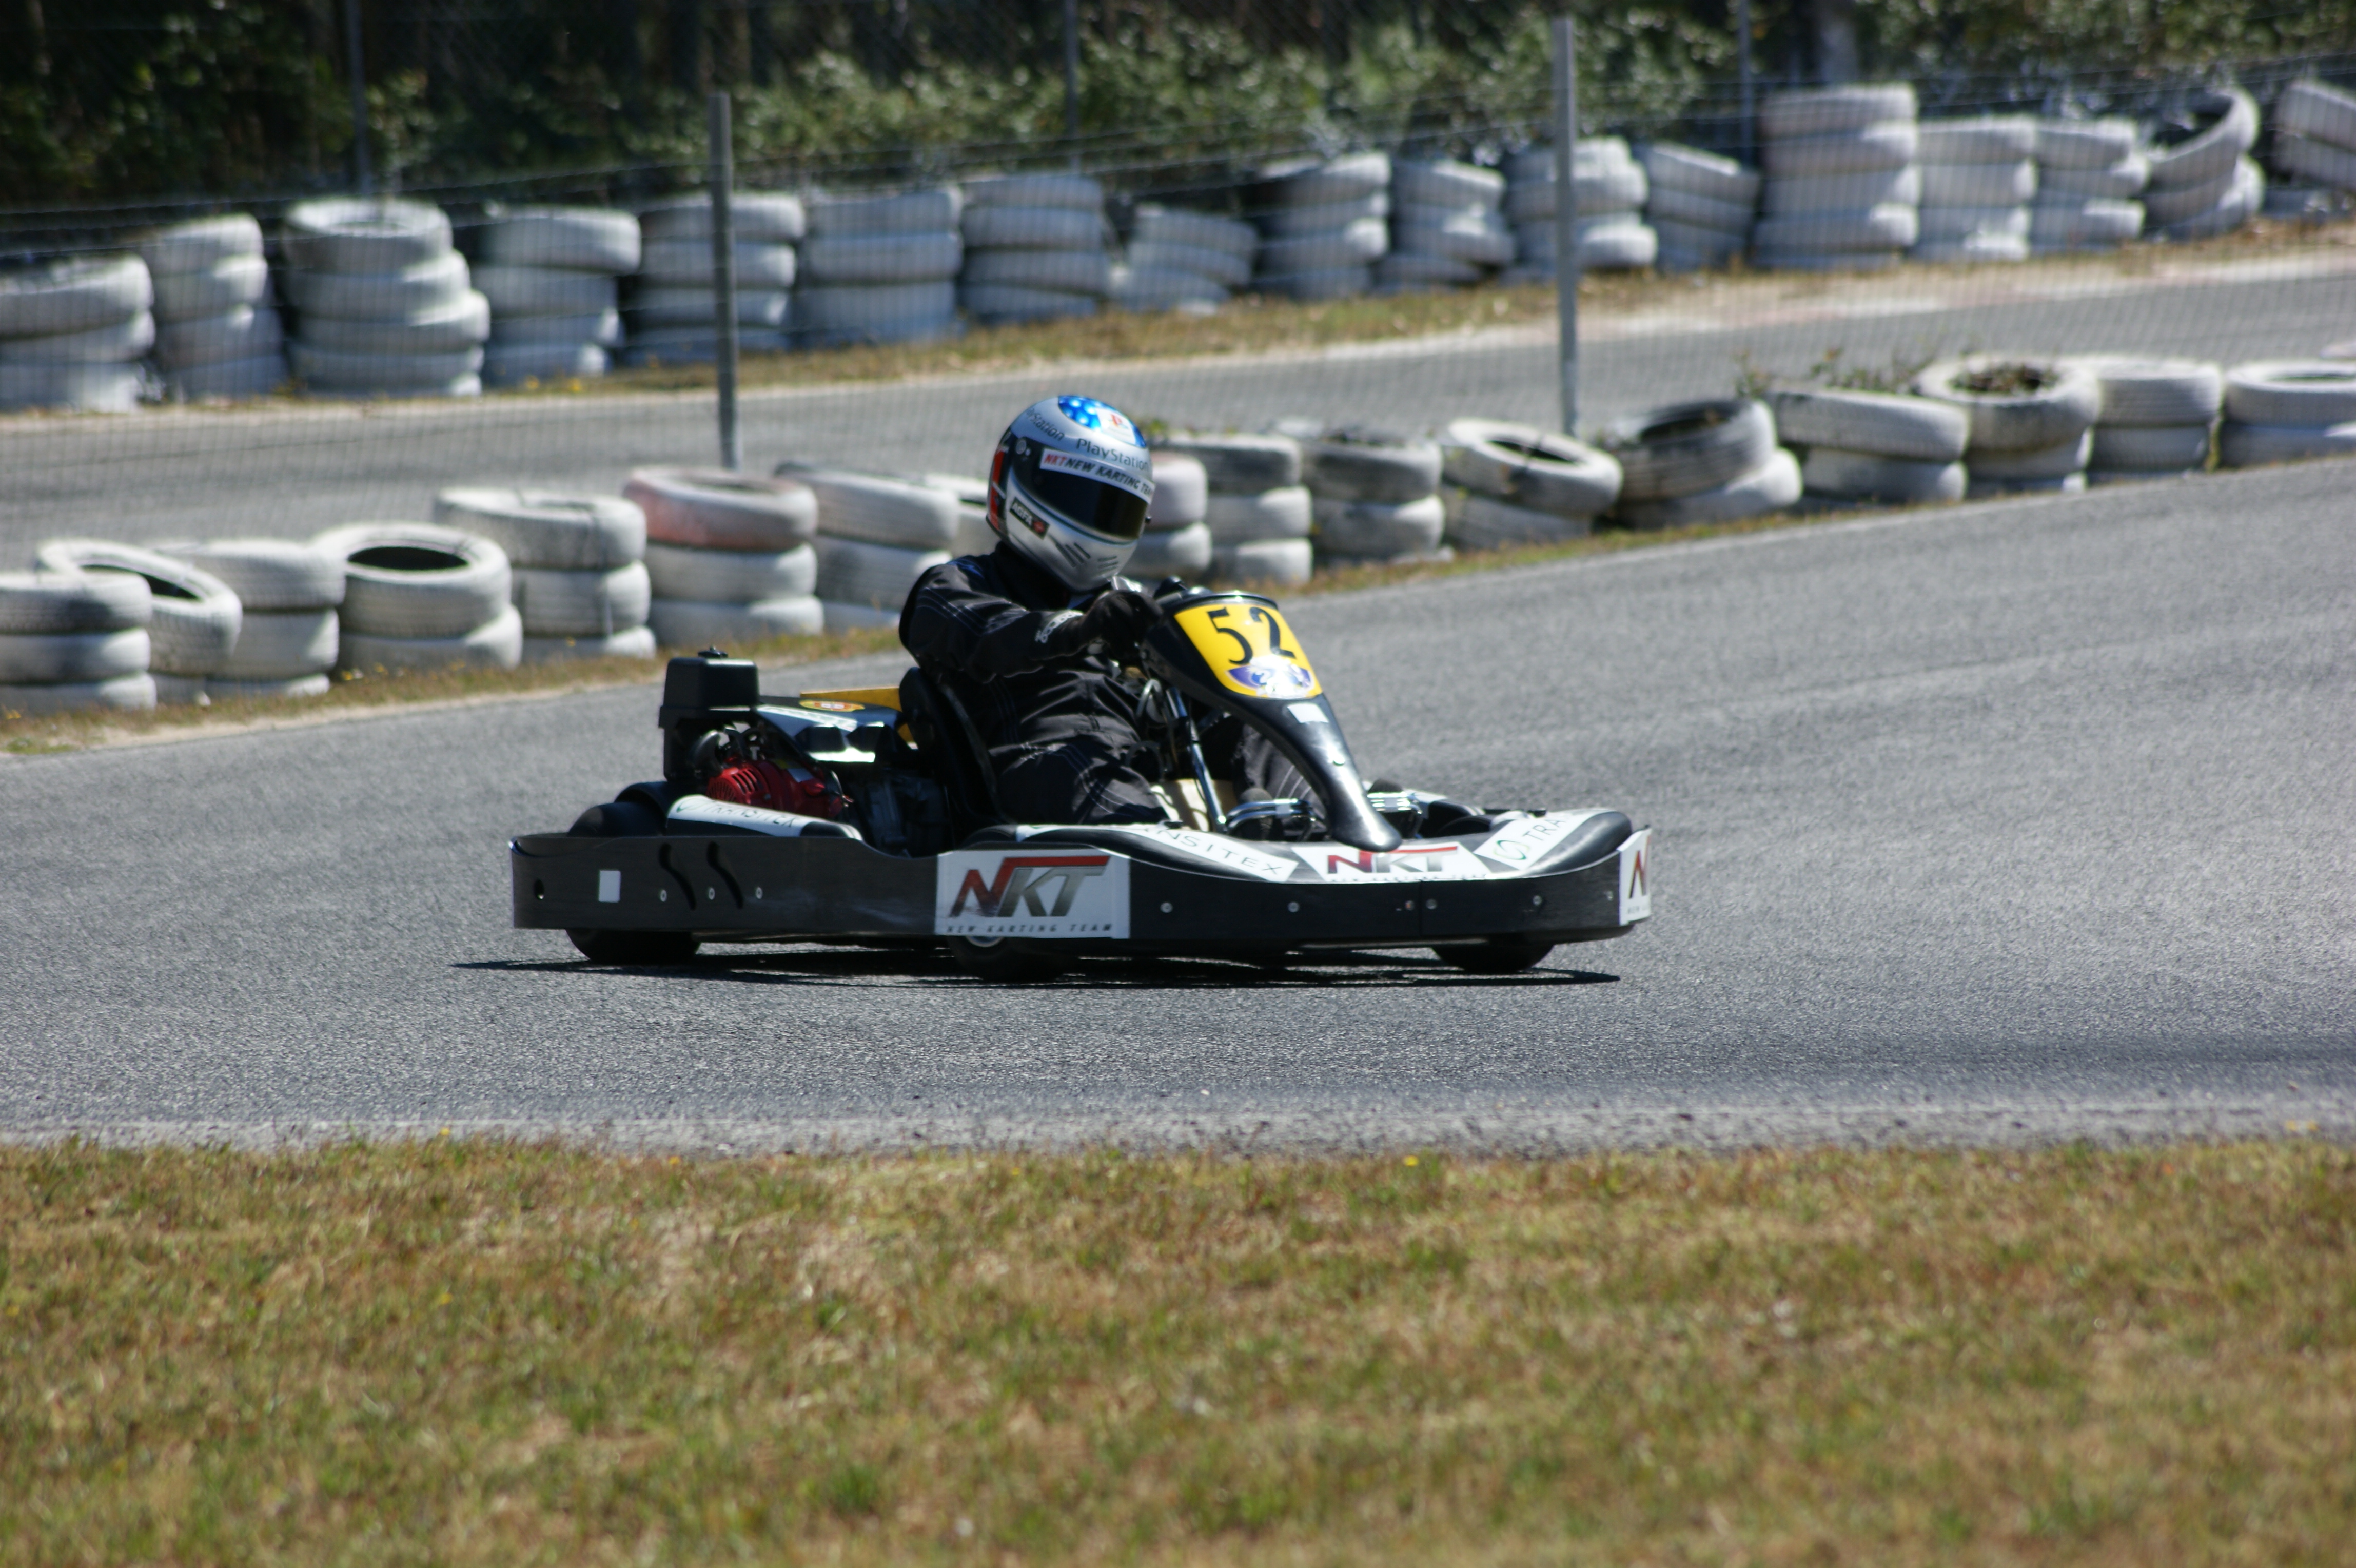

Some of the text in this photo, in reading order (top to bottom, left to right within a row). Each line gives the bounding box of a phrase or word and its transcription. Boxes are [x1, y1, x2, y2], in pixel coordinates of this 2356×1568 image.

[1077, 438, 1149, 471] PlayStation
[1096, 466, 1140, 489] KARTING
[1207, 606, 1297, 665] 52
[1144, 828, 1282, 875] NSITEX
[1327, 846, 1458, 874] NKT
[949, 855, 1111, 917] NKT
[987, 924, 1057, 933] KARTING
[1070, 924, 1112, 932] TEAM
